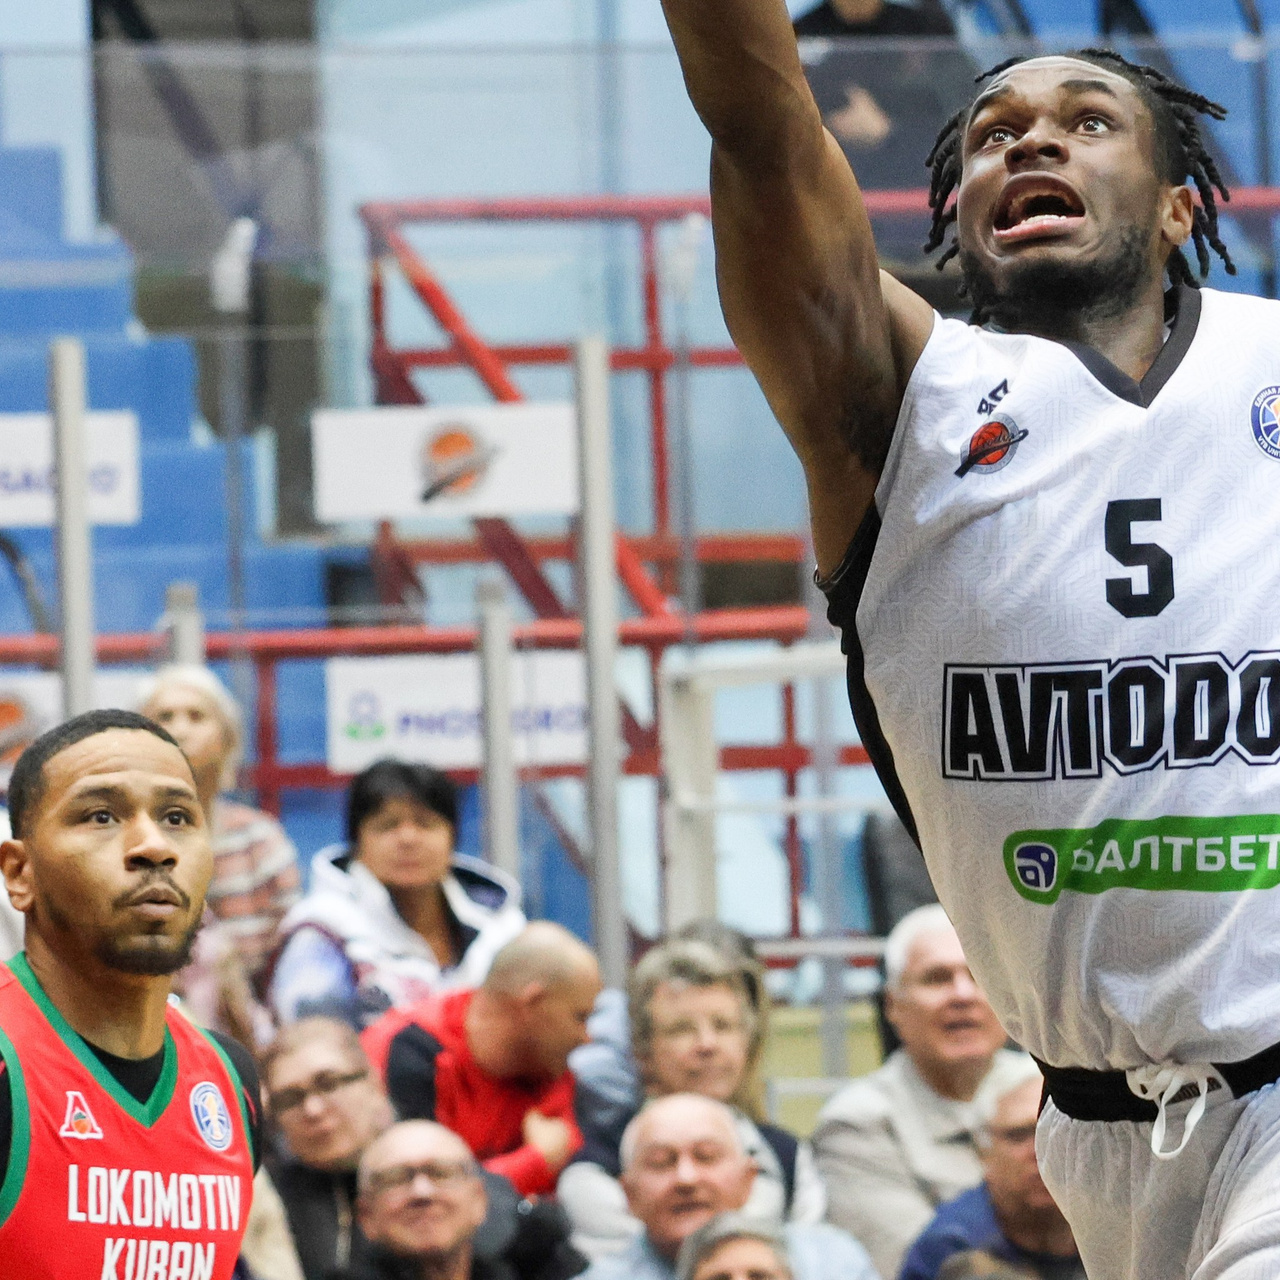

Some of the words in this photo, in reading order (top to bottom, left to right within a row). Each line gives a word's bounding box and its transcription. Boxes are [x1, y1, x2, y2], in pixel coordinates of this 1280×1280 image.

[1104, 498, 1174, 618] 5
[68, 1163, 240, 1231] LOKOMOTIV
[100, 1237, 216, 1280] KUBAN
